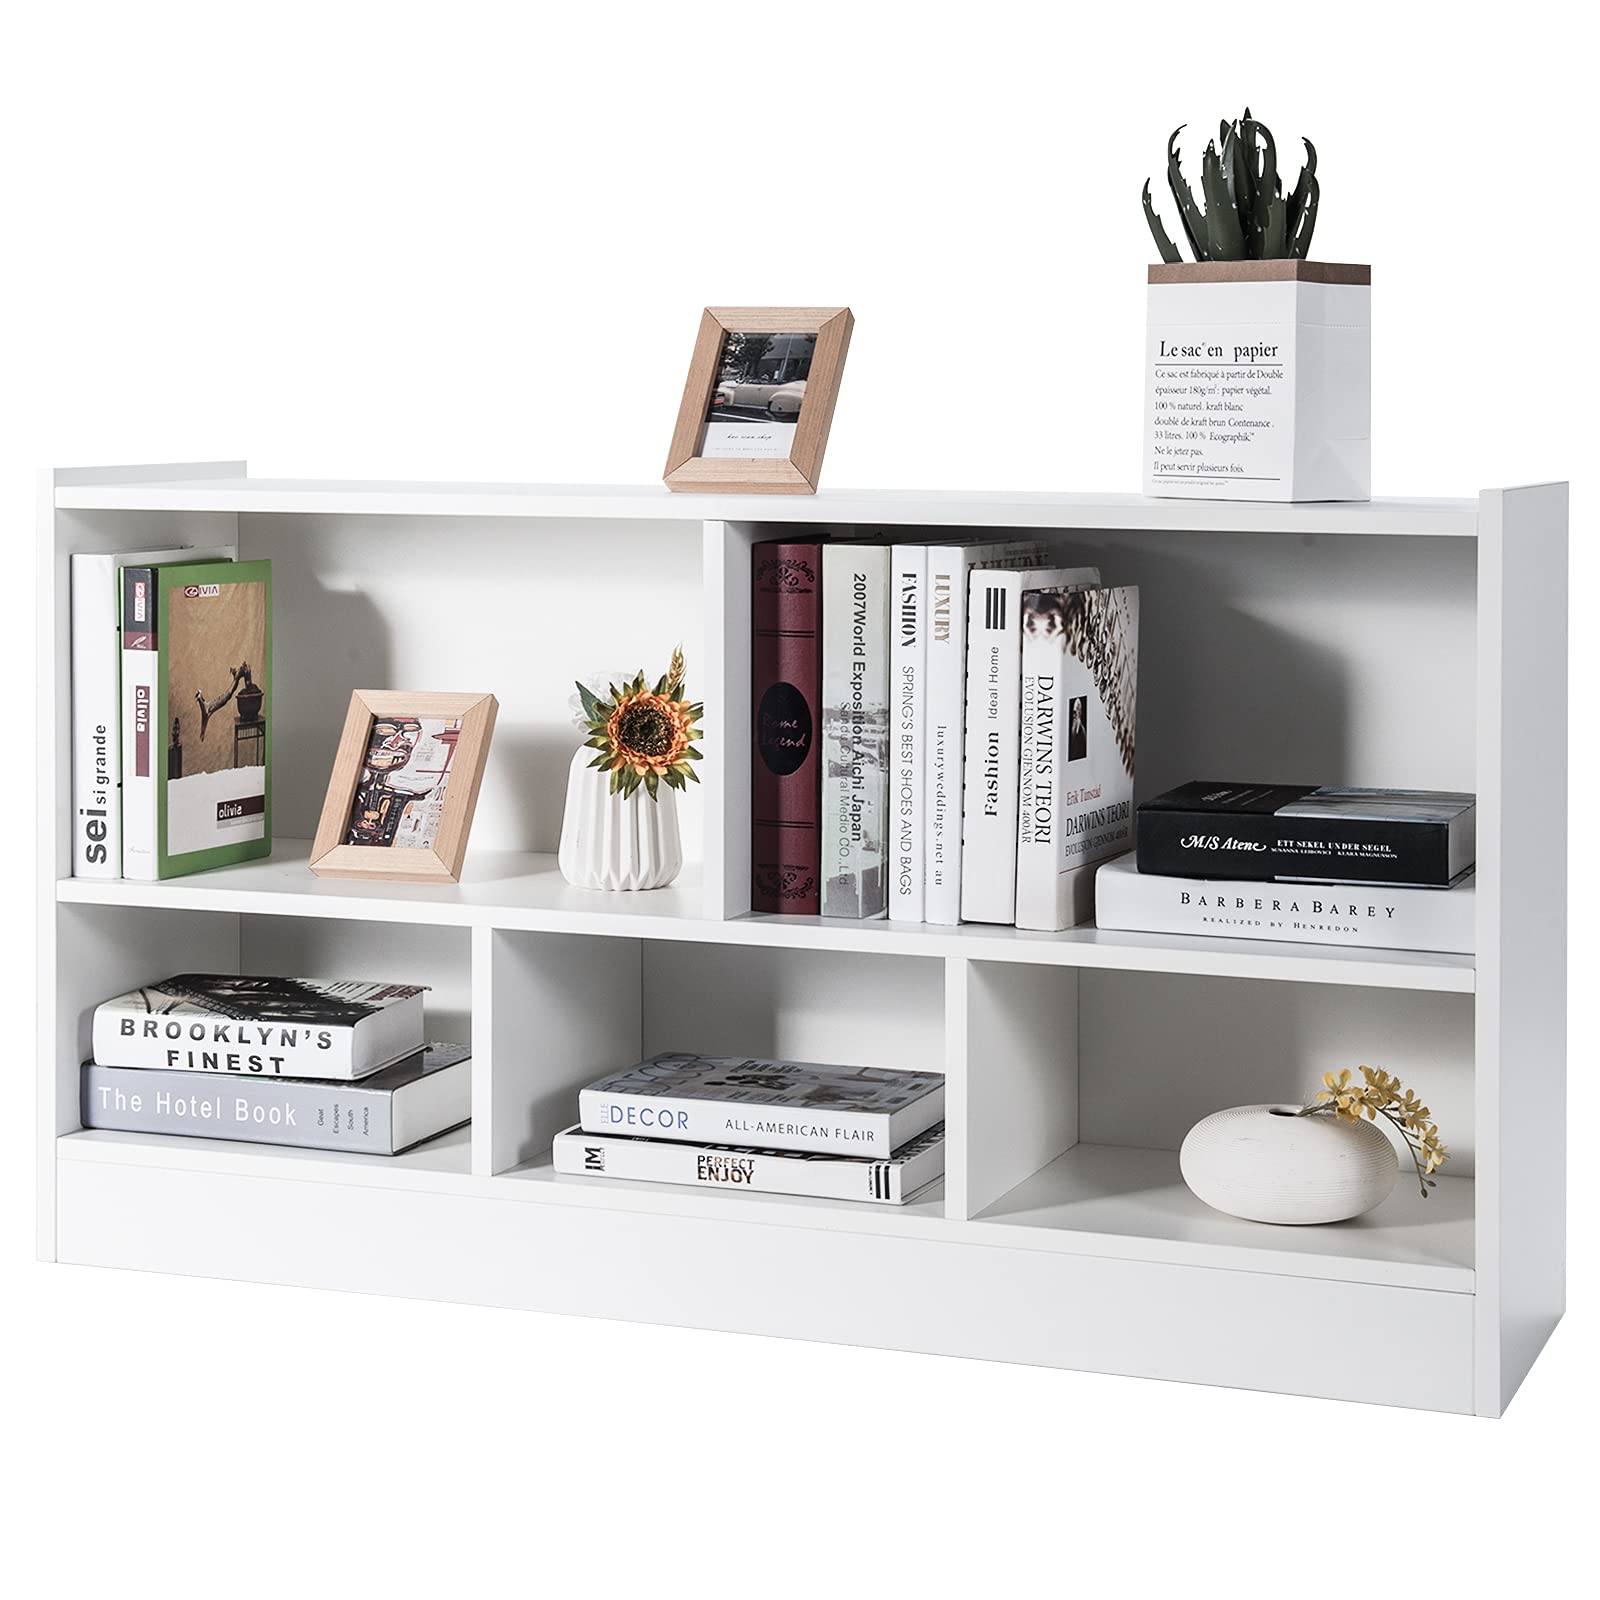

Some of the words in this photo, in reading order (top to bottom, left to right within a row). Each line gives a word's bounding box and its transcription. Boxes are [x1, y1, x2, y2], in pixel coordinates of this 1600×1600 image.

[1160, 340, 1178, 357] Le
[1207, 346, 1223, 357] en
[1233, 341, 1279, 363] papier
[1155, 369, 1165, 378] Ce
[1190, 368, 1220, 381] fabriqué
[1220, 369, 1225, 378] à
[1226, 370, 1246, 381] partir
[1246, 369, 1256, 378] de
[1257, 369, 1284, 379] Double
[1155, 386, 1187, 397] épaisseur
[1221, 386, 1244, 397] papier
[1155, 402, 1168, 410] 100
[1169, 402, 1176, 410] %
[1206, 402, 1223, 411] kraft
[1224, 402, 1244, 411] blanc
[1154, 416, 1179, 426] doublé
[1181, 417, 1190, 426] de
[1190, 416, 1207, 426] kraft
[1208, 417, 1226, 427] brun
[1154, 431, 1163, 439] 33
[1185, 431, 1198, 440] 100
[1199, 432, 1206, 440] %
[1154, 446, 1165, 455] Ne
[1166, 446, 1173, 455] le
[1173, 447, 1189, 458] jetez
[1160, 464, 1176, 473] peut
[1177, 463, 1196, 471] servir
[1196, 462, 1229, 474] plusieurs
[901, 573, 917, 648] FASHION
[934, 574, 950, 645] LUXURY
[988, 646, 999, 683] Home
[137, 688, 149, 732] olivia
[850, 660, 865, 745] Exposition
[901, 666, 914, 730] SPRING'S
[987, 688, 998, 719] Ideal
[1035, 675, 1054, 774] DARWINS
[93, 724, 110, 785] grande
[901, 734, 913, 764] BEST
[852, 749, 865, 790] Aichi
[984, 731, 999, 817] Fashion
[900, 768, 912, 816] SHOES
[219, 803, 242, 818] olivia
[840, 795, 850, 833] Medio
[849, 794, 864, 842] Japan
[1034, 780, 1053, 844] TEORI
[1066, 807, 1105, 837] DARWINS
[1106, 800, 1130, 824] TEORI
[79, 808, 108, 864] sei
[900, 819, 912, 852] AND
[1181, 835, 1220, 850] M/S
[1220, 837, 1267, 852] Atene
[1297, 841, 1325, 849] SEKEL
[1328, 842, 1360, 850] UNDER
[1362, 844, 1392, 853] SEGEL
[900, 856, 911, 895] BAGS
[1181, 892, 1300, 912] BARBERA
[1312, 901, 1396, 918] BAREY
[1203, 917, 1261, 926] REALIZED
[120, 1018, 333, 1050] BROOKLYN'S
[166, 1050, 285, 1074] FINEST
[98, 1086, 142, 1112] The
[156, 1091, 221, 1120] Hotel
[235, 1098, 298, 1126] Book
[332, 1104, 340, 1134] Escapes
[610, 1105, 689, 1130] DECOR
[725, 1119, 829, 1138] ALL-AMERICAN
[835, 1128, 875, 1142] FLAIR
[697, 1166, 755, 1184] ENJOY
[698, 1155, 755, 1170] PERFECT
